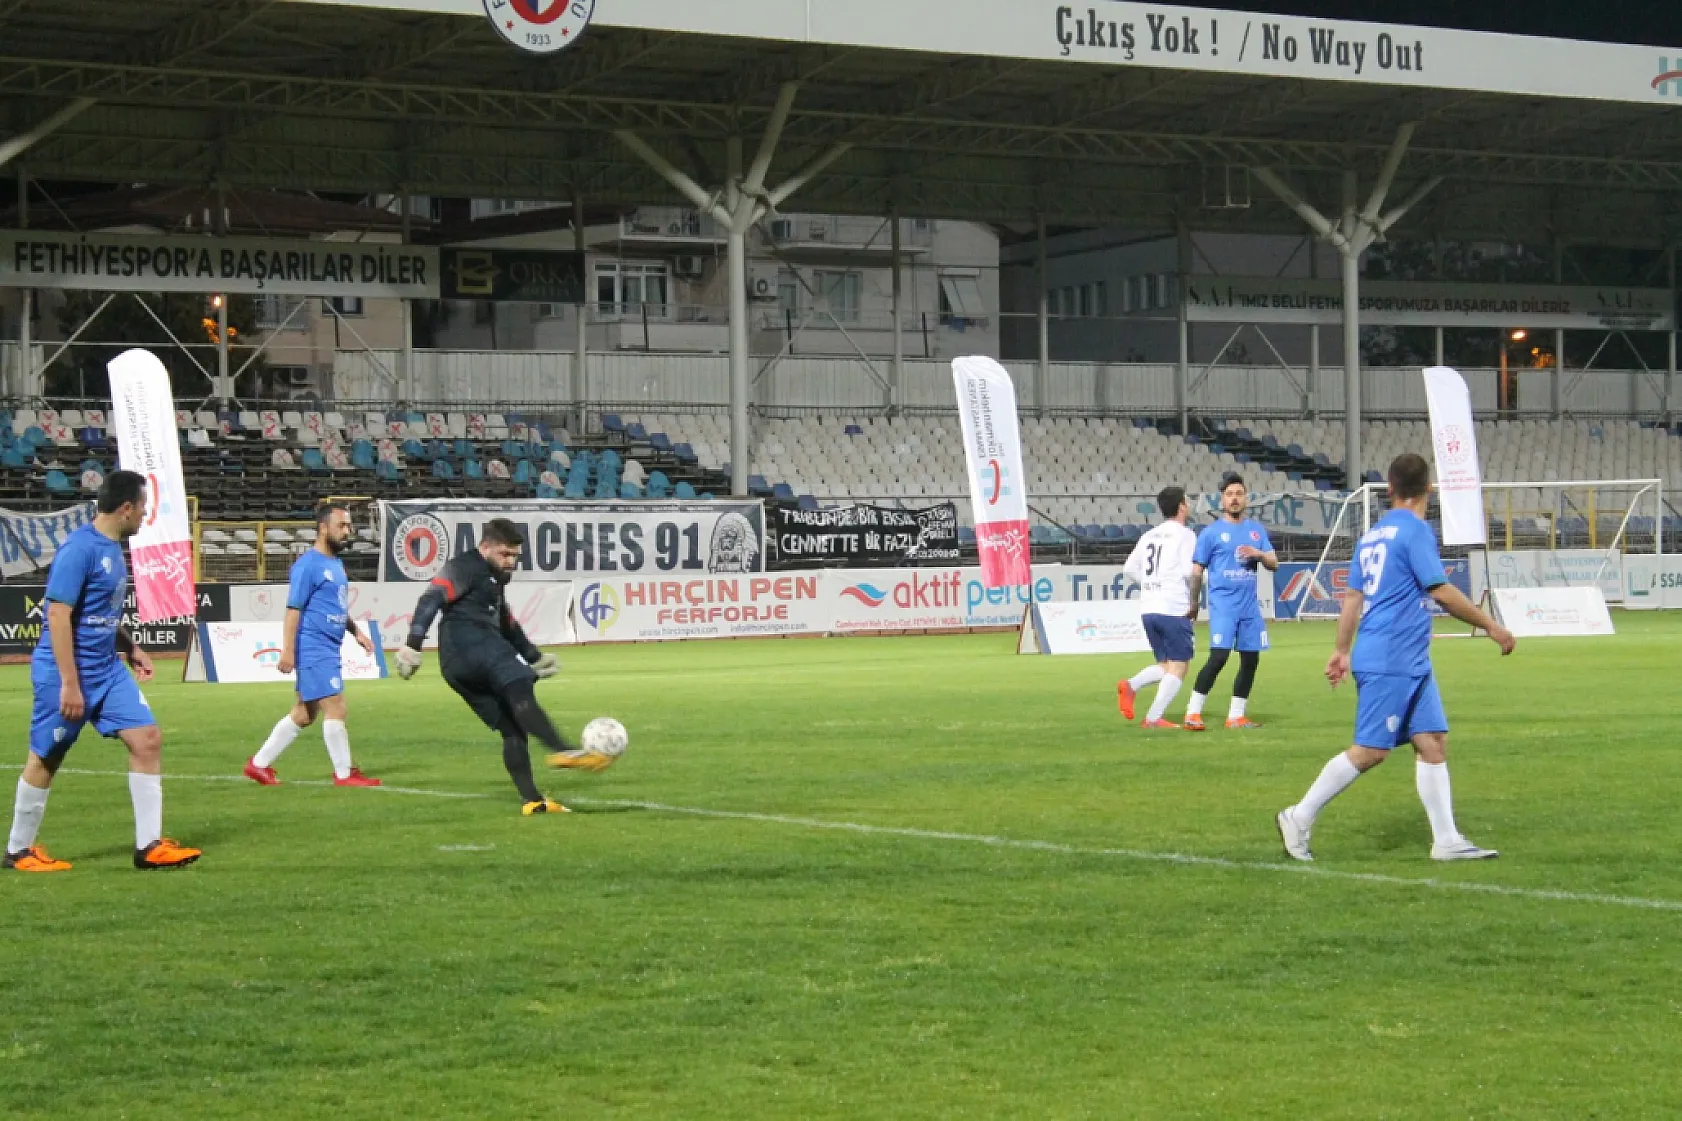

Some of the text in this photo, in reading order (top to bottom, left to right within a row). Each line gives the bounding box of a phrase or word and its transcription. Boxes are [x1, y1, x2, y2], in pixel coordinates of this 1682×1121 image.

[525, 32, 551, 45] 1933
[1056, 6, 1135, 60] Çıkış
[1146, 13, 1200, 54] Yok
[1262, 23, 1297, 62] No
[1308, 27, 1366, 74] Way
[1377, 32, 1423, 71] Out
[14, 235, 426, 288] FETHİYESPOR'A BAŞARILAR DİLER
[509, 261, 579, 286] ORKA
[455, 521, 703, 571] AACHES 91
[1145, 542, 1163, 577] 31
[624, 576, 817, 606] HIRÇIN PEN
[893, 571, 962, 609] aktif
[656, 604, 789, 625] FERFORJE
[132, 628, 177, 645] DİLER
